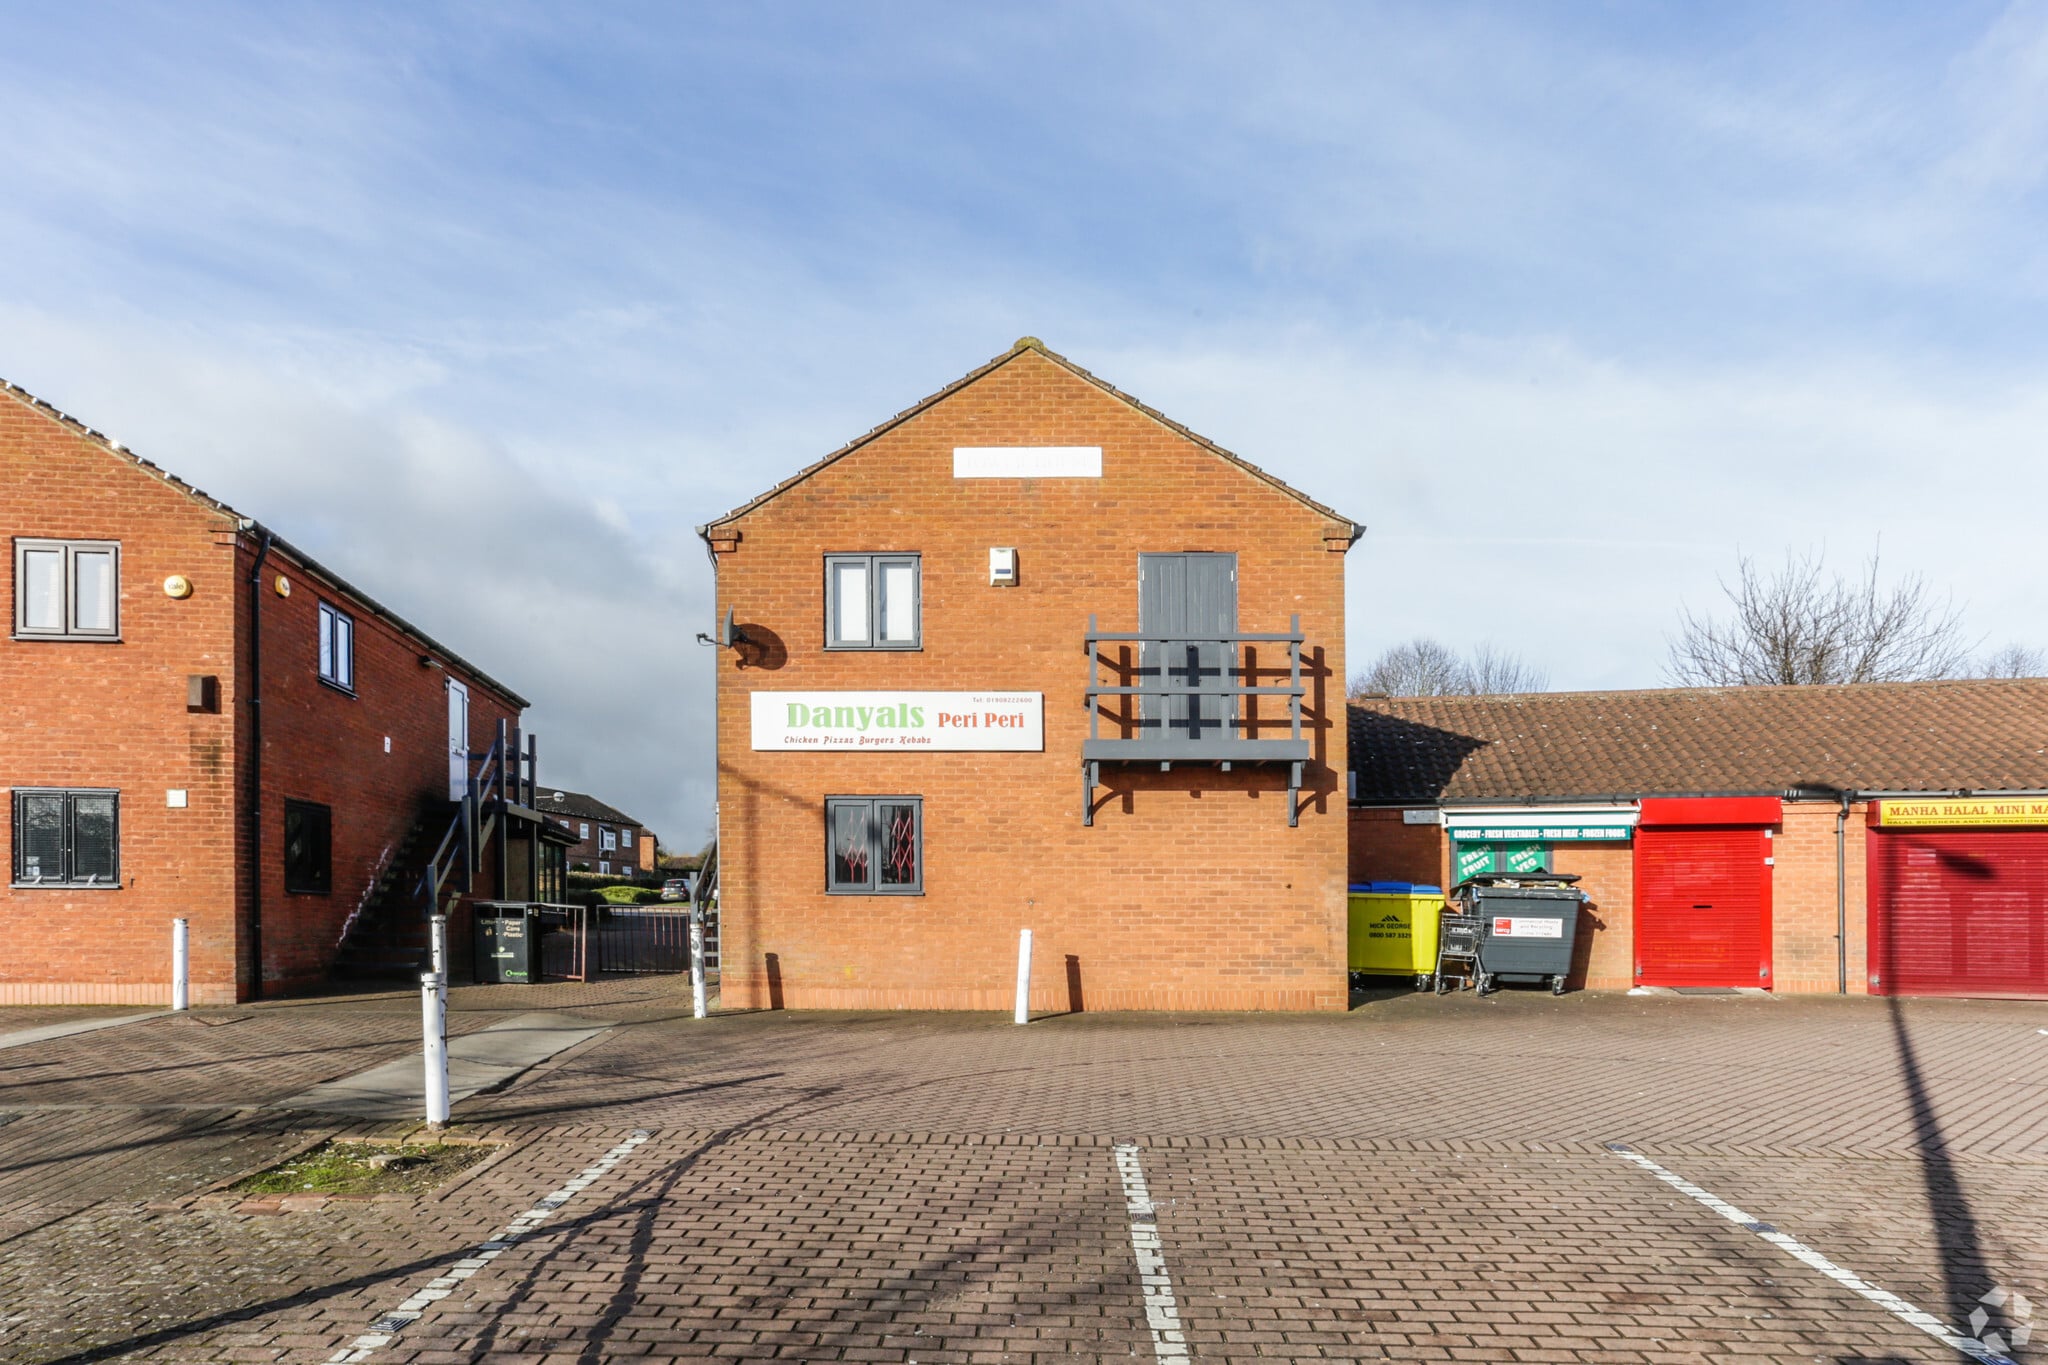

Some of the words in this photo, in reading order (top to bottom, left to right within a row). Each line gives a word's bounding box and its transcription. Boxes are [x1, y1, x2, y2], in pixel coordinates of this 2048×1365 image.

[786, 703, 925, 731] Danyals
[938, 712, 978, 728] Peri
[984, 712, 1025, 728] Peri
[784, 735, 819, 744] Chicken
[823, 735, 854, 745] Pizzas
[858, 735, 894, 745] Burgers
[899, 735, 931, 745] Kebabs
[1889, 807, 1938, 816] MANHA
[1944, 806, 1988, 815] HALAL
[1994, 805, 2026, 815] MINI
[1453, 829, 1481, 839] GROCERY
[1583, 828, 1605, 838] FROZEN
[1606, 828, 1626, 838] FOODS
[1460, 844, 1491, 866] FRESH
[1510, 843, 1541, 865] FRESH
[1462, 856, 1490, 876] FRUIT
[1515, 857, 1537, 873] VEG
